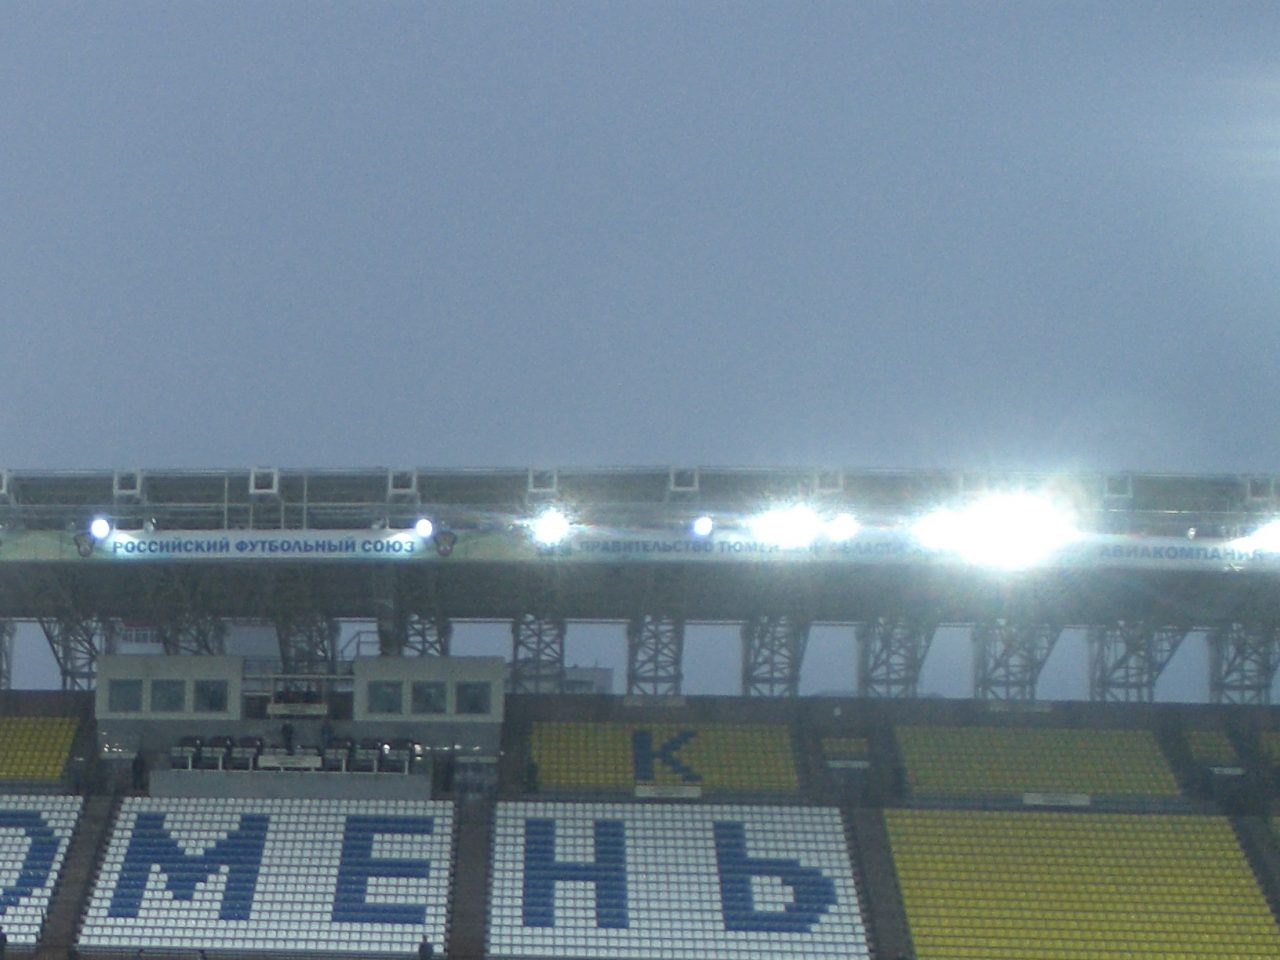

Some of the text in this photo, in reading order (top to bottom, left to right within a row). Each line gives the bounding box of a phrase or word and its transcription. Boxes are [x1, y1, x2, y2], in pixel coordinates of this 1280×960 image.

[112, 537, 414, 554] РОССИЙСКИЙ ФУТБОЛЬНЫЙ СОЮЗ
[580, 540, 714, 554] ПРАВИТЕЛЬСТВО
[631, 729, 703, 782] К
